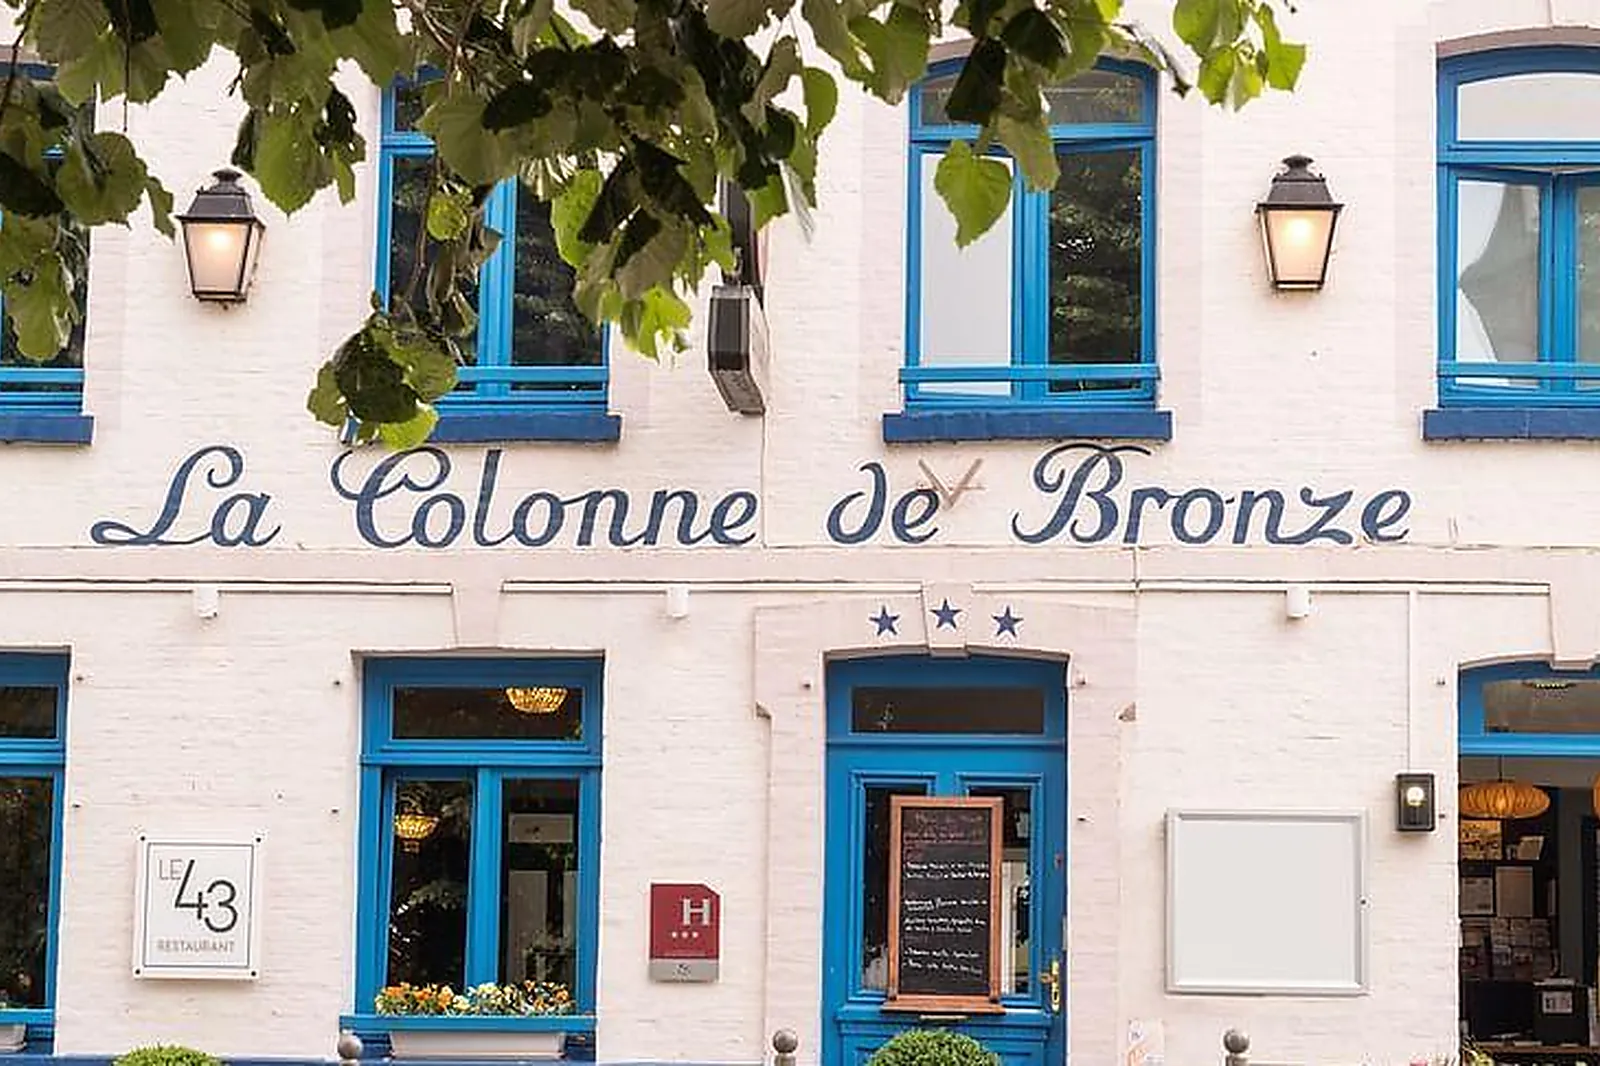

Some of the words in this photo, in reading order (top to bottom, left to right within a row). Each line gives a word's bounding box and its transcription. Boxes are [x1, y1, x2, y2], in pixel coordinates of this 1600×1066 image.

[90, 445, 281, 548] La
[330, 445, 759, 549] Colonne
[826, 460, 940, 545] de
[1011, 442, 1412, 545] Bronze
[158, 858, 182, 880] LE
[174, 859, 238, 933] 43
[682, 898, 711, 926] H
[156, 938, 236, 954] RESTAURANT
